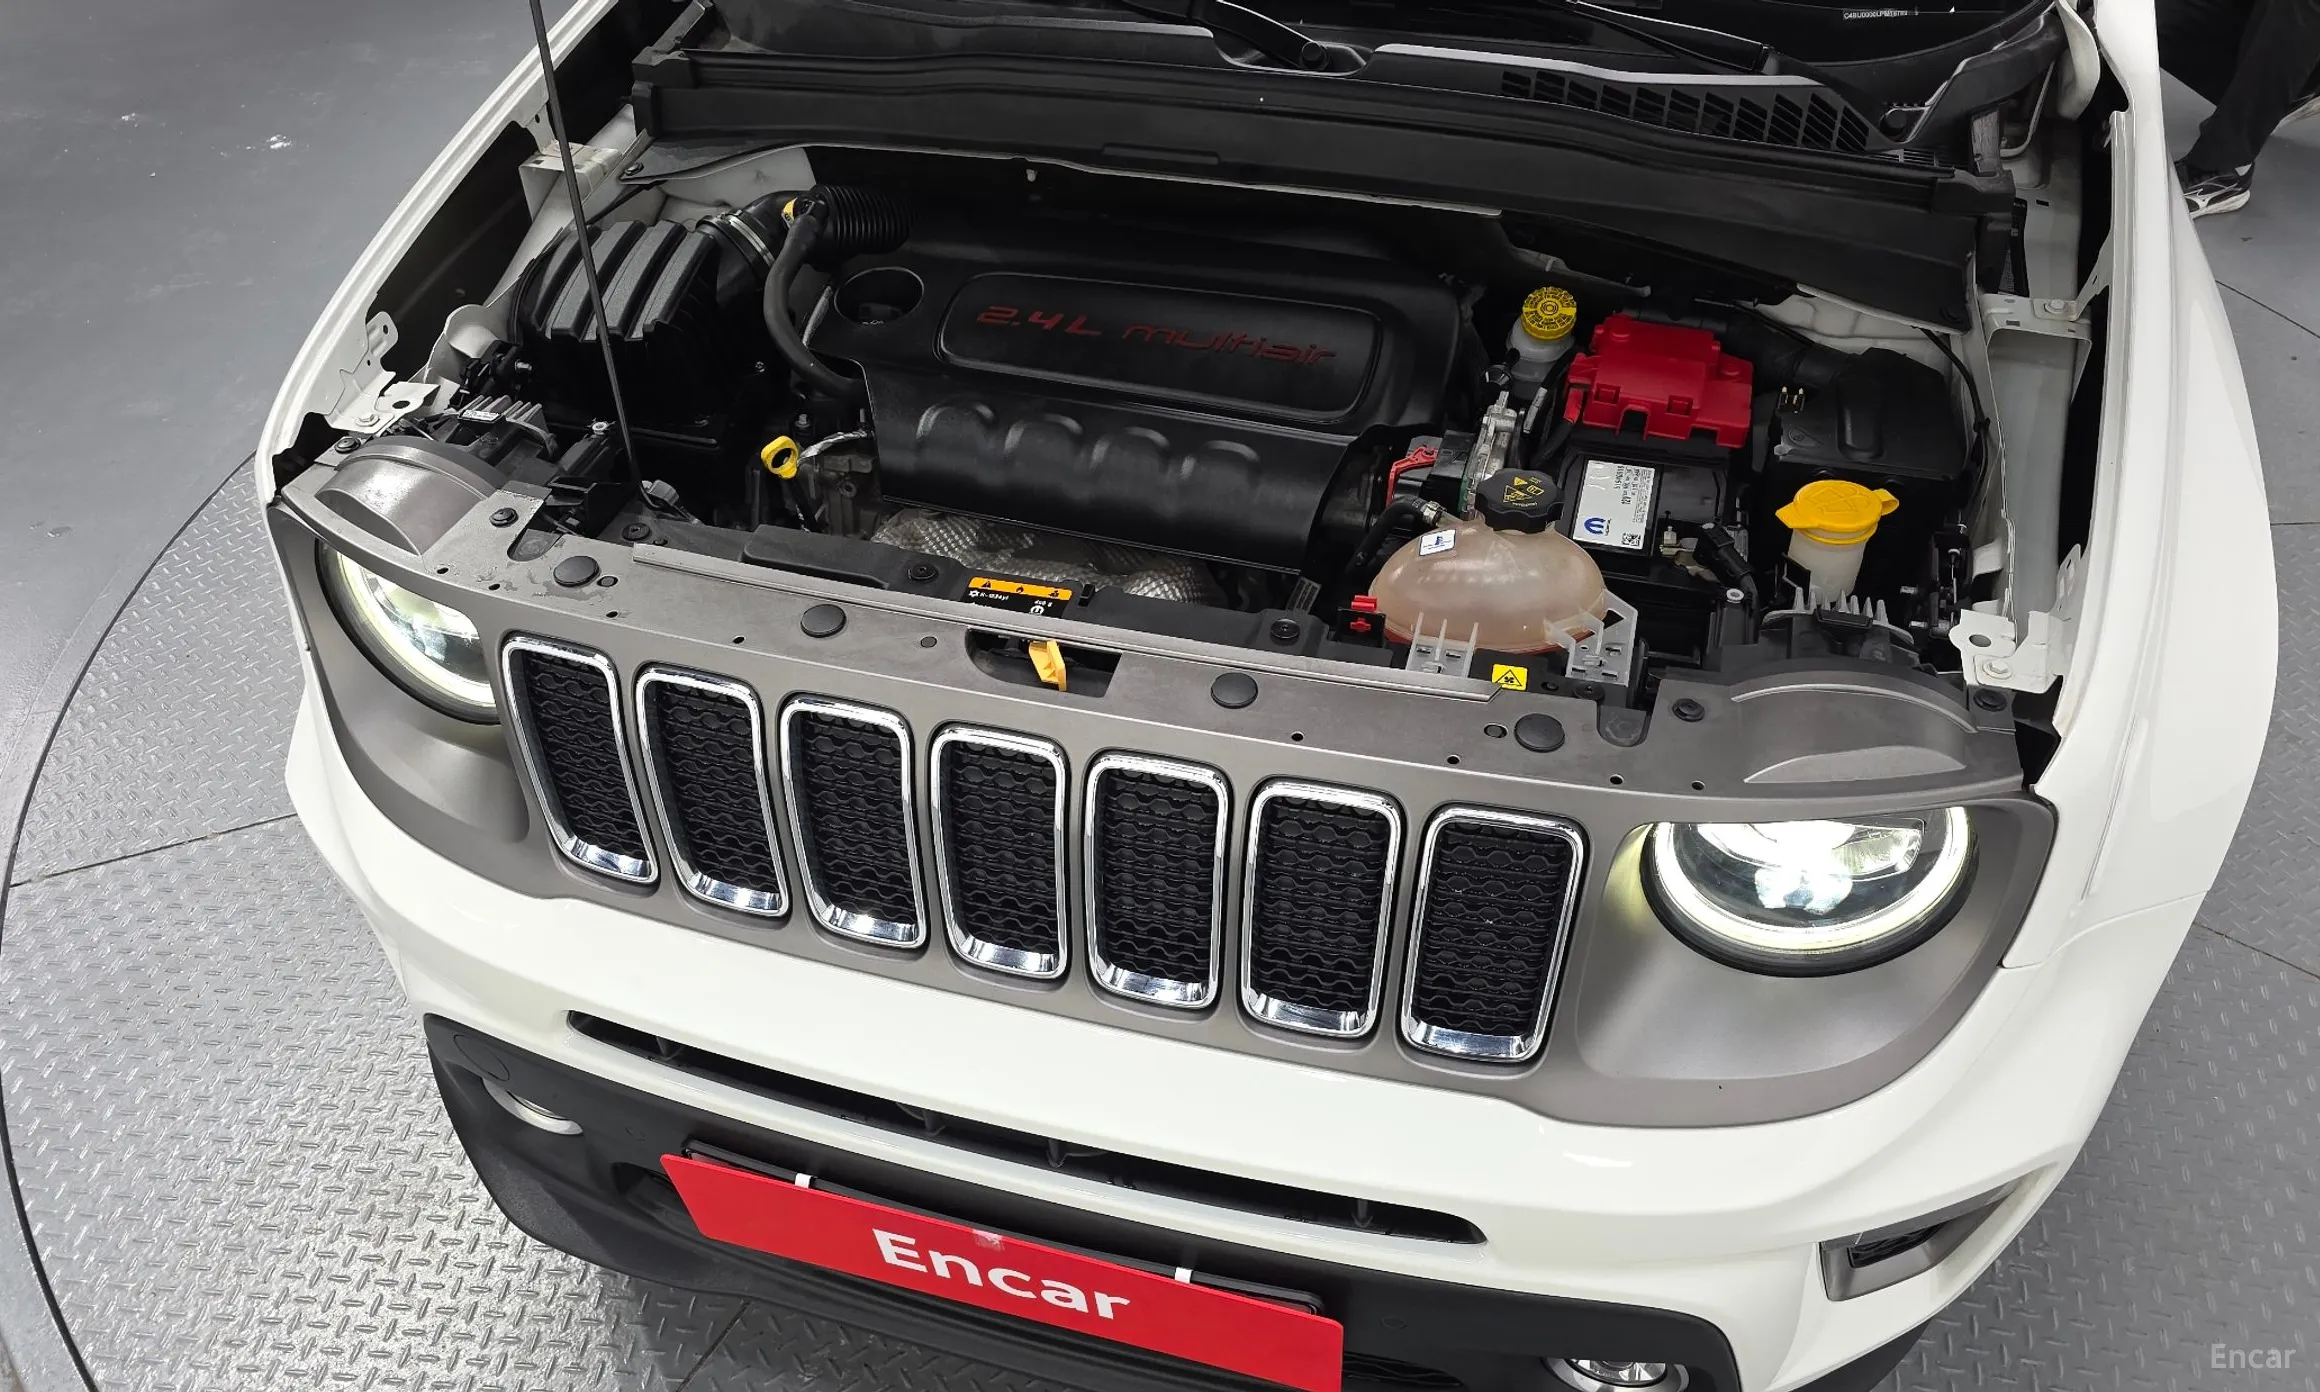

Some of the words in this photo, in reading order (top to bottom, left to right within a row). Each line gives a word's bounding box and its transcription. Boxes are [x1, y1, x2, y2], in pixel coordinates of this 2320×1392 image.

[976, 306, 1102, 336] 2.4L
[1122, 324, 1337, 364] multiair
[872, 1228, 1131, 1320] Encar
